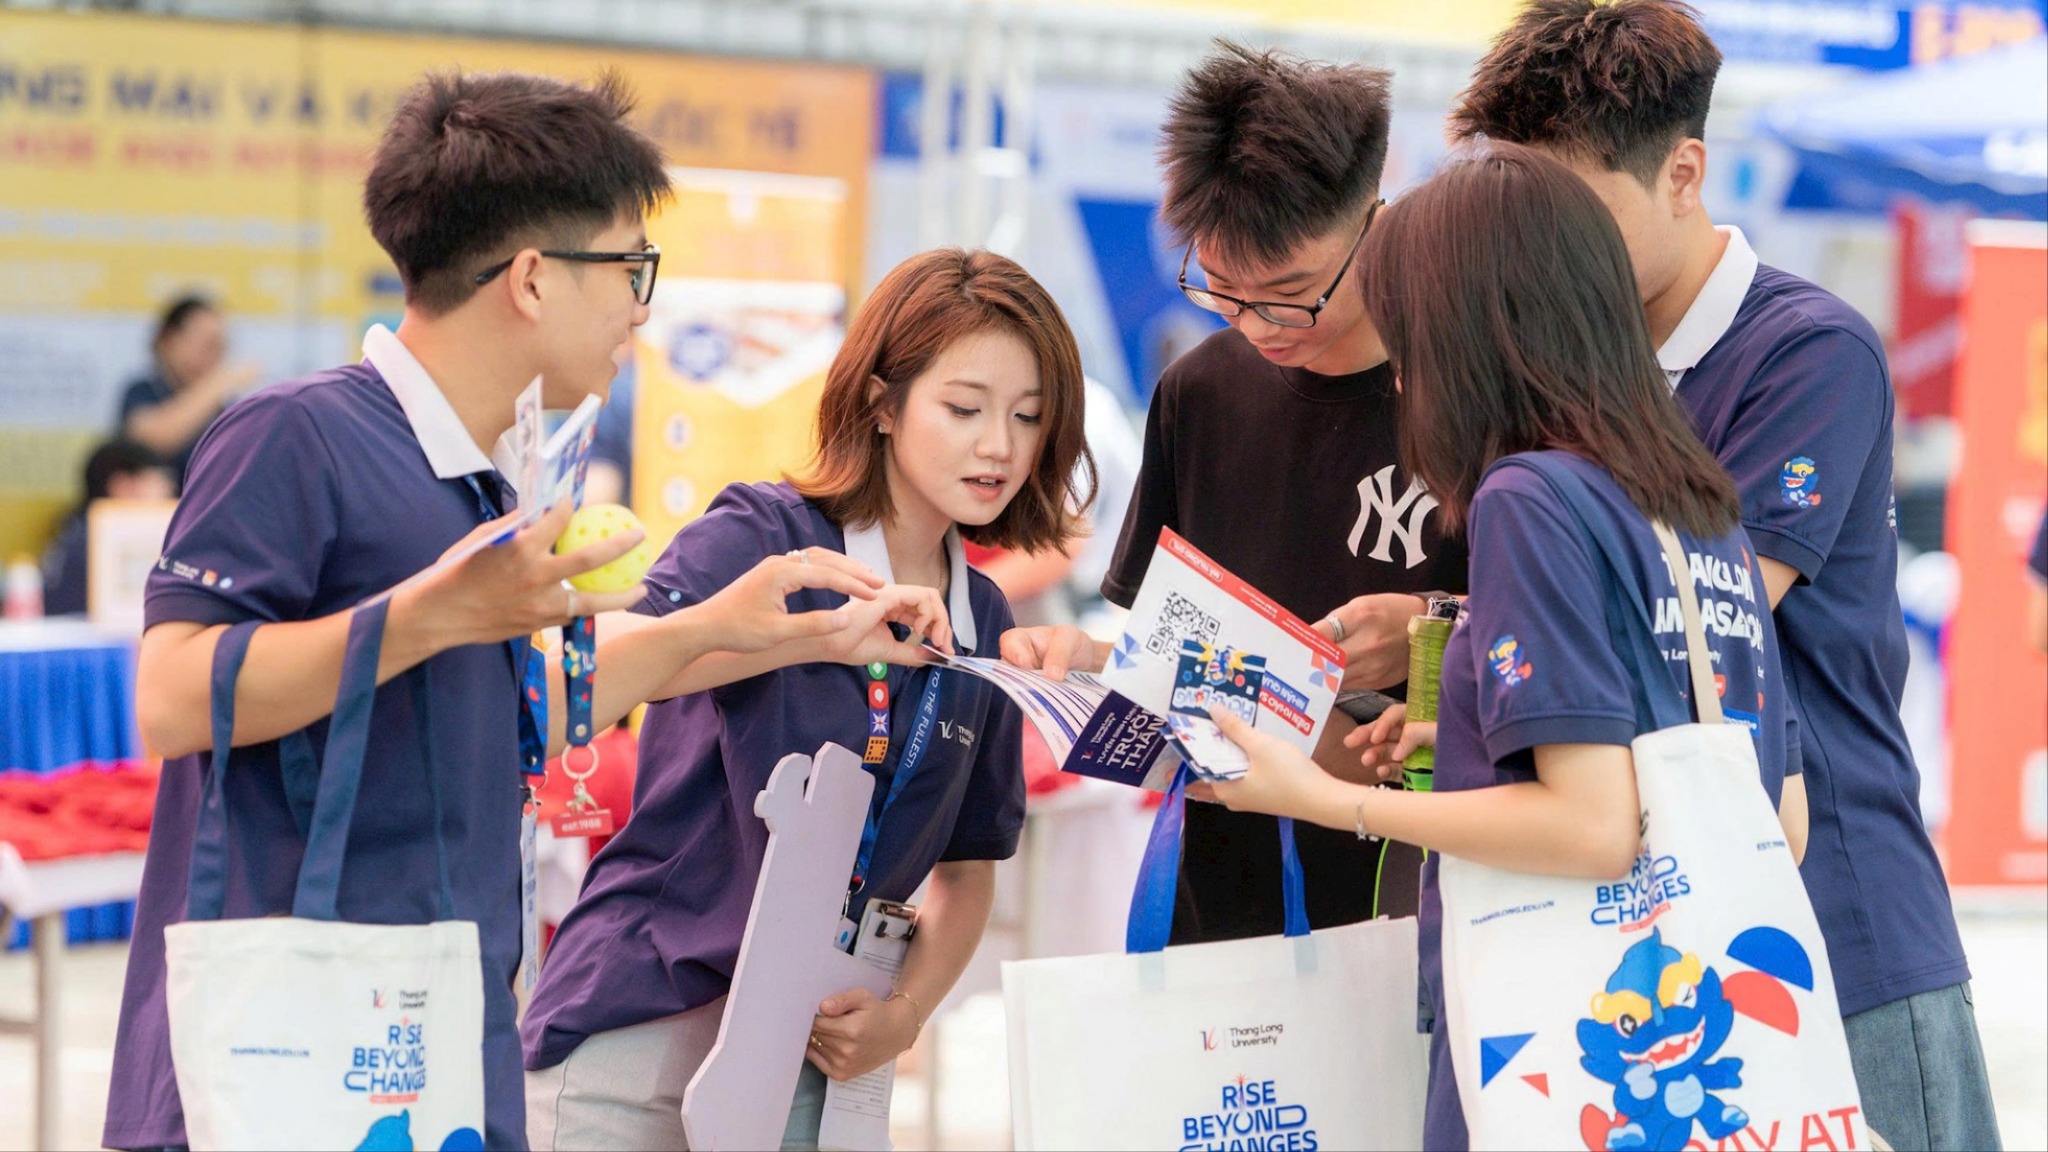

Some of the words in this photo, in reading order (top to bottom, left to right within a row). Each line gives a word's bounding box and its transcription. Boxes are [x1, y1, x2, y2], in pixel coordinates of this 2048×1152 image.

[1347, 464, 1439, 569] NY
[931, 671, 940, 688] TO
[924, 691, 936, 715] THE
[1229, 1026, 1260, 1037] Thang
[1260, 1024, 1283, 1034] Long
[1231, 1035, 1278, 1048] University
[1222, 1080, 1277, 1110] RISE
[1183, 1104, 1307, 1142] BEYOND
